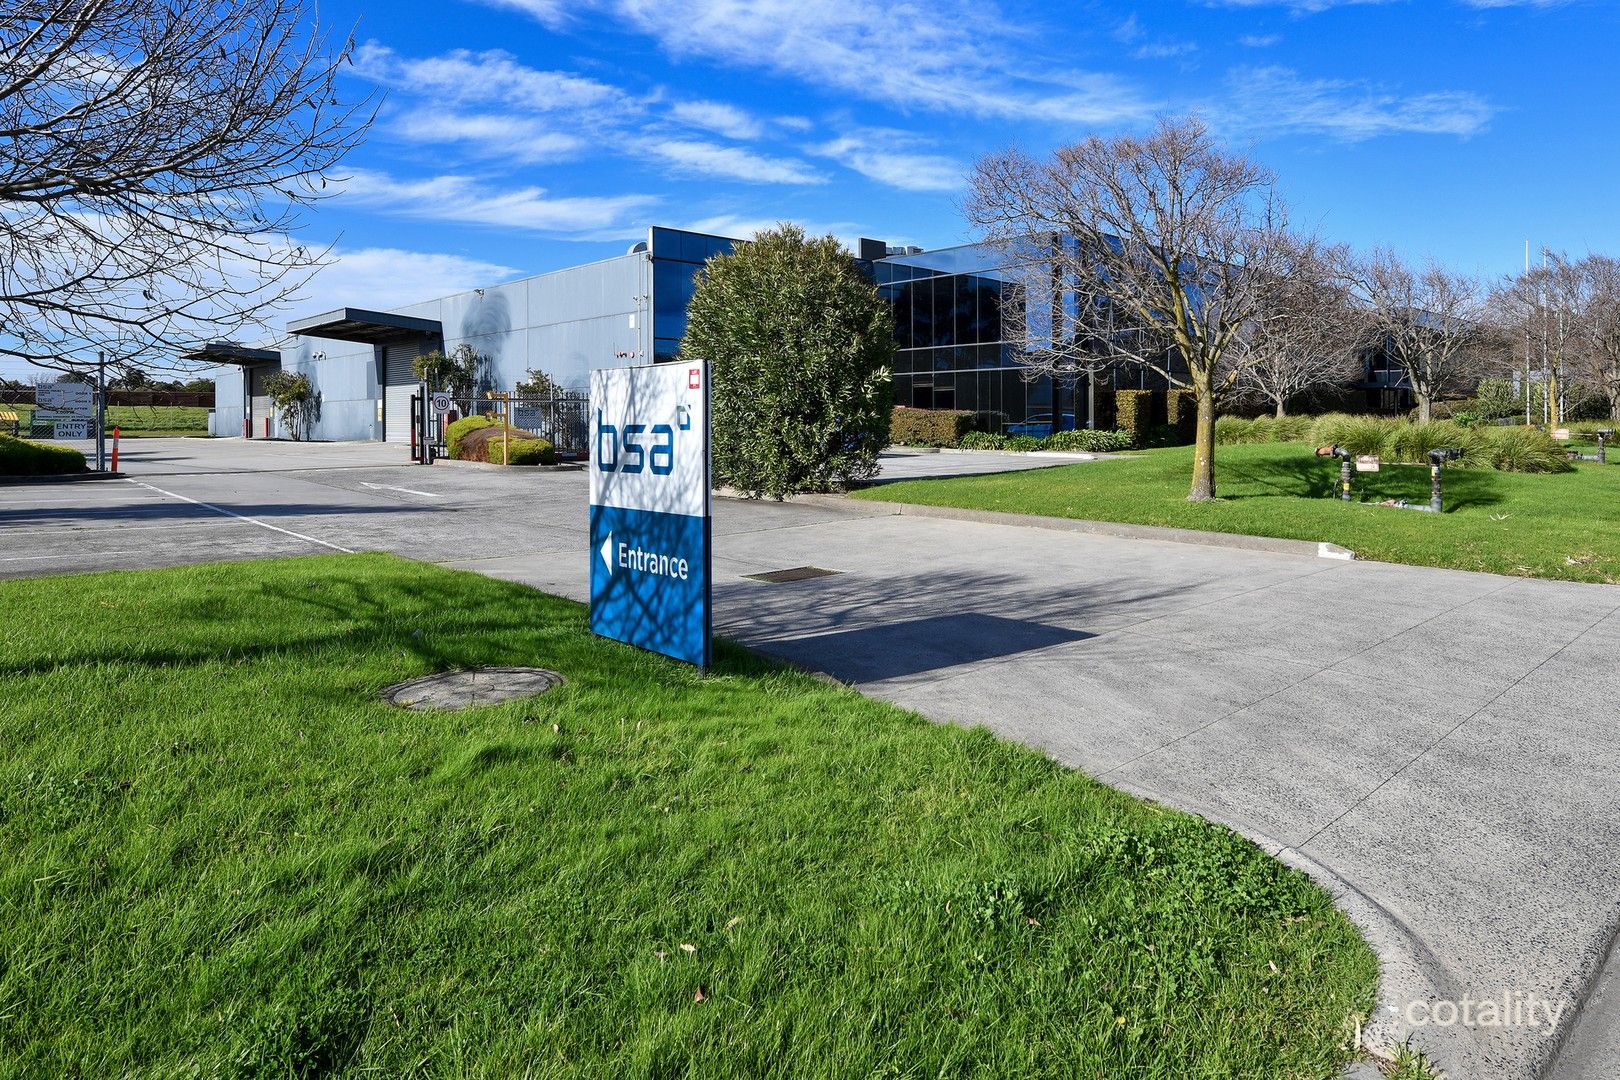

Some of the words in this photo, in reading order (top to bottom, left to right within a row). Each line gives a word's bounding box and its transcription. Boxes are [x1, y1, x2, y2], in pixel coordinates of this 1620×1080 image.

[436, 399, 447, 407] 10
[598, 408, 674, 475] bsa
[619, 542, 688, 580] Entrance
